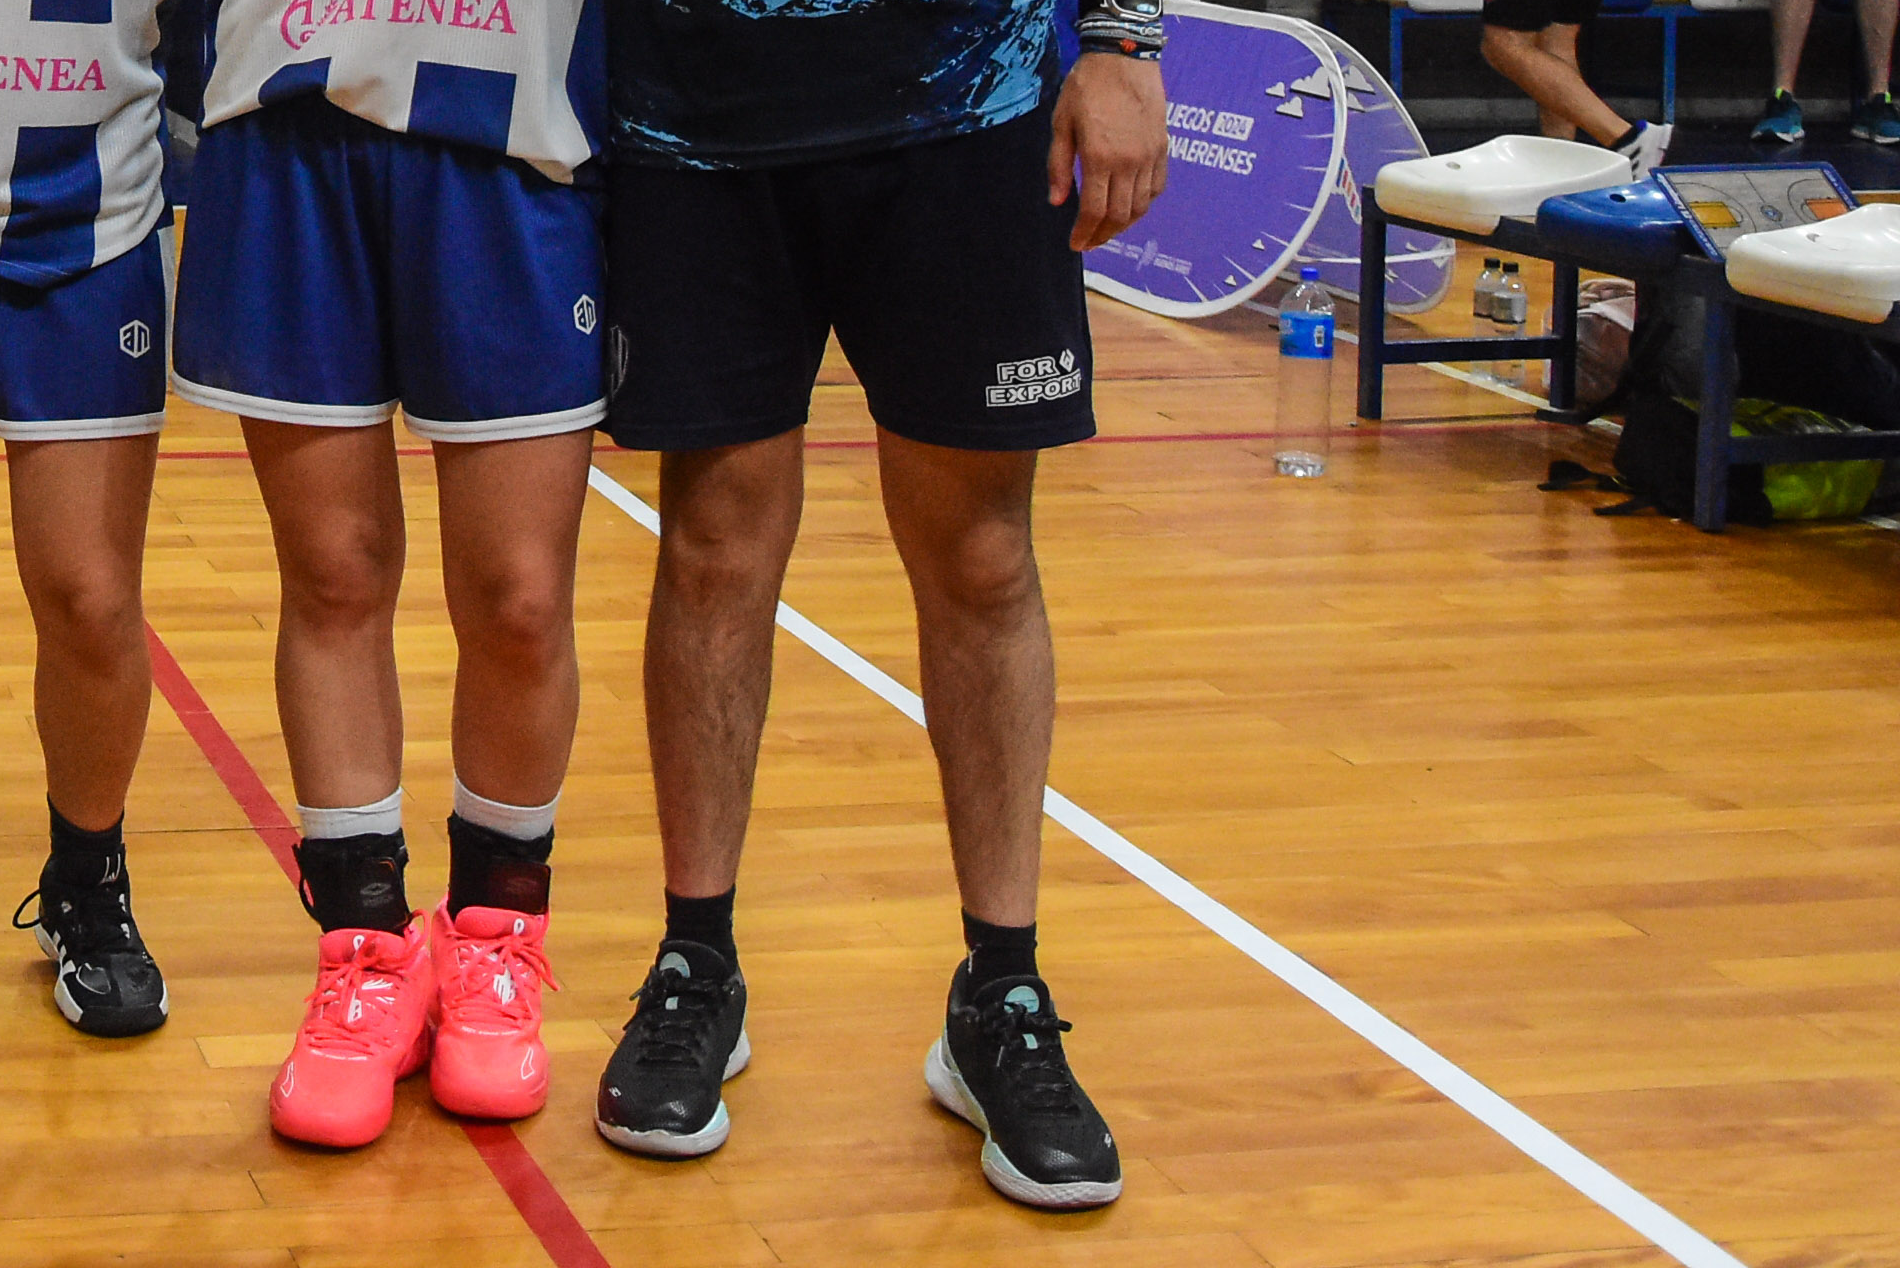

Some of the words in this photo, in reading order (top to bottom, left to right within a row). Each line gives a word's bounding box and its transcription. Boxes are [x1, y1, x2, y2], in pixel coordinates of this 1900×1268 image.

[1166, 101, 1215, 133] UEGOS
[1166, 133, 1257, 175] NAERENSES
[998, 357, 1058, 383] FOR
[987, 369, 1082, 406] EXPORT
